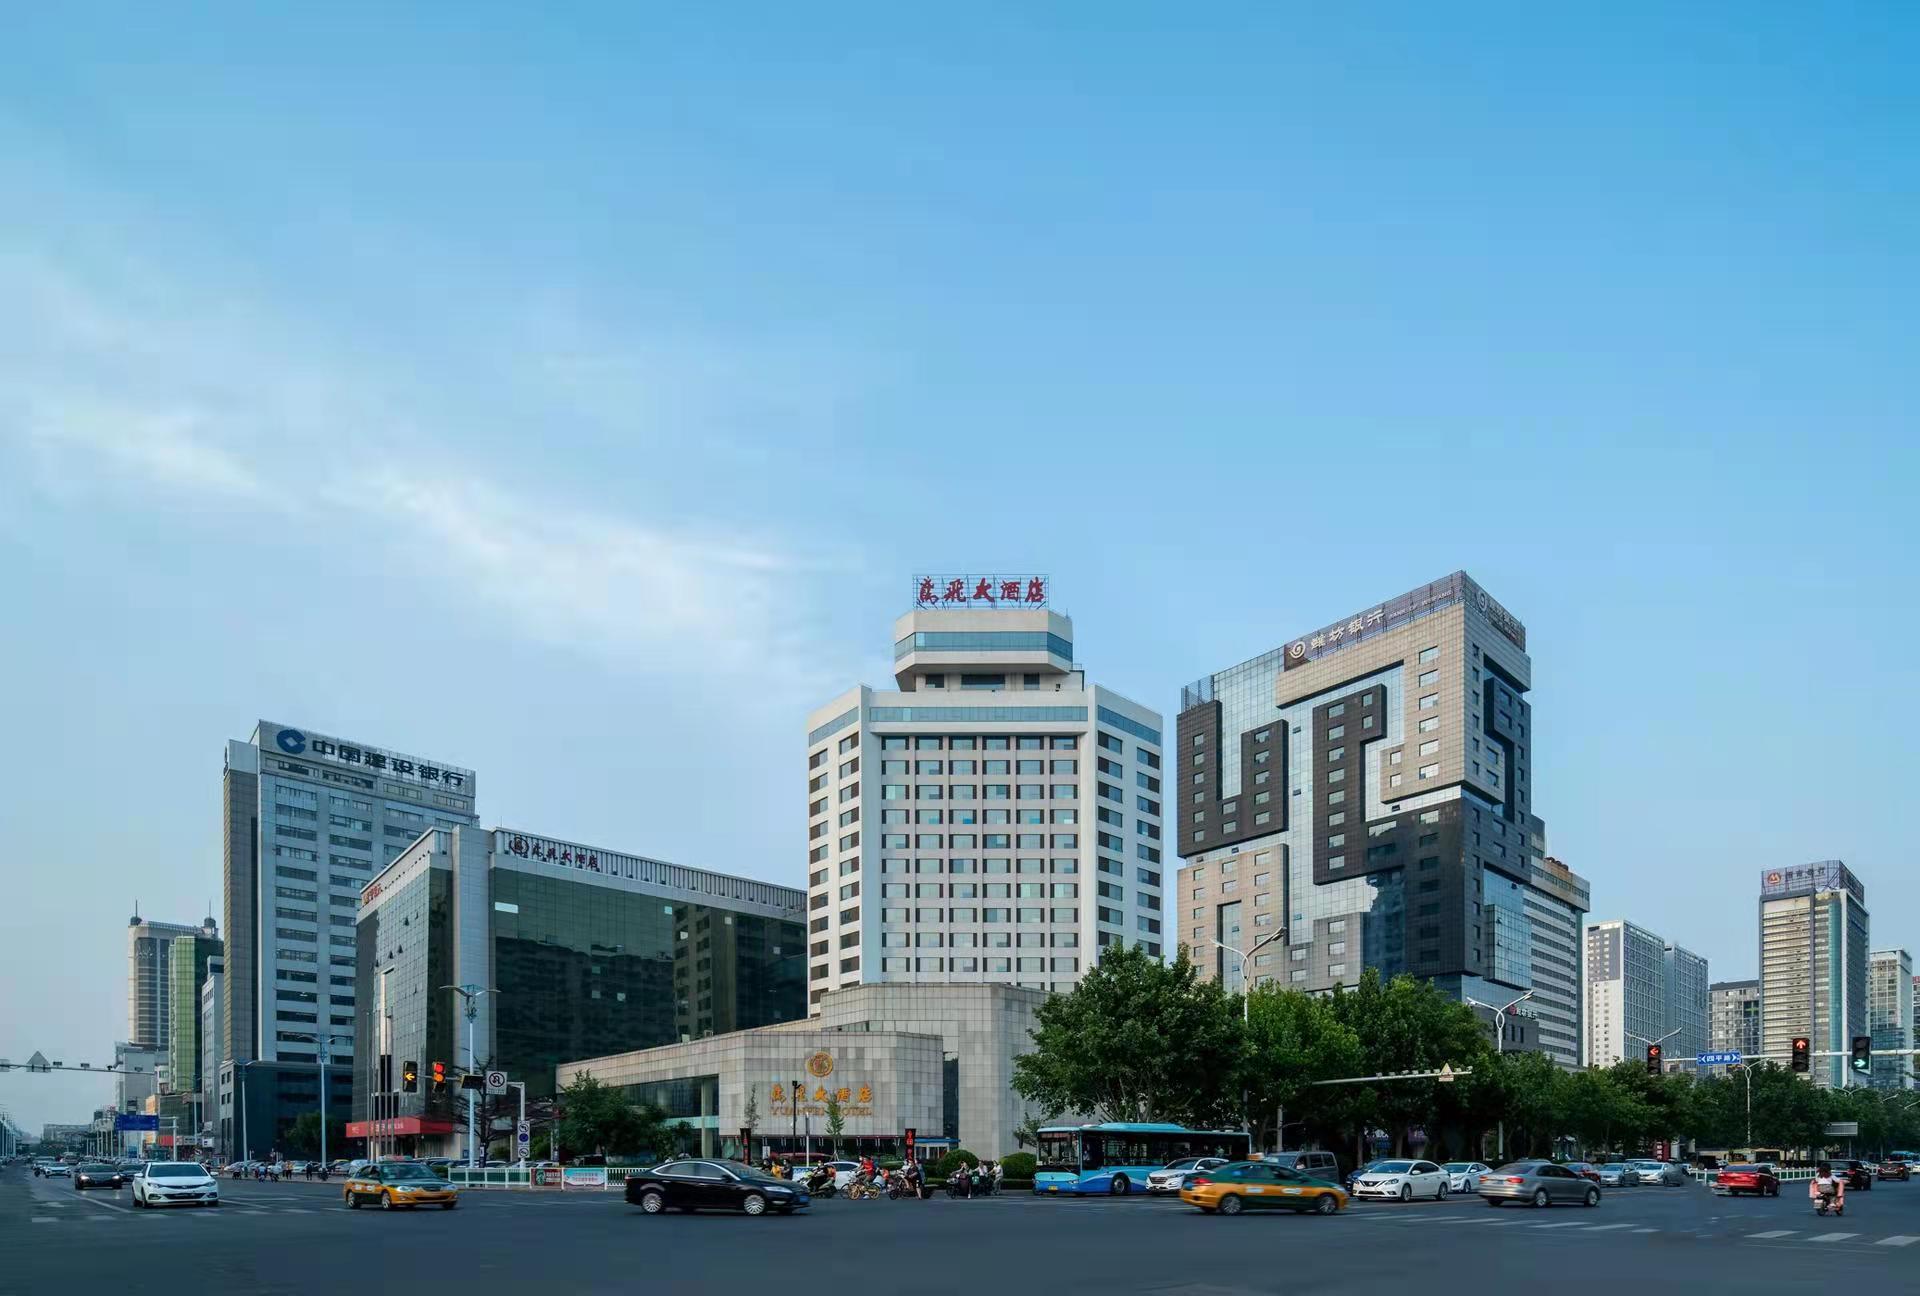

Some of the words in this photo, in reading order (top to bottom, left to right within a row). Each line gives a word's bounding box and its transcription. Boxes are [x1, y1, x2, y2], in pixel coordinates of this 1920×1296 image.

[312, 740, 464, 787] 中国建设银行
